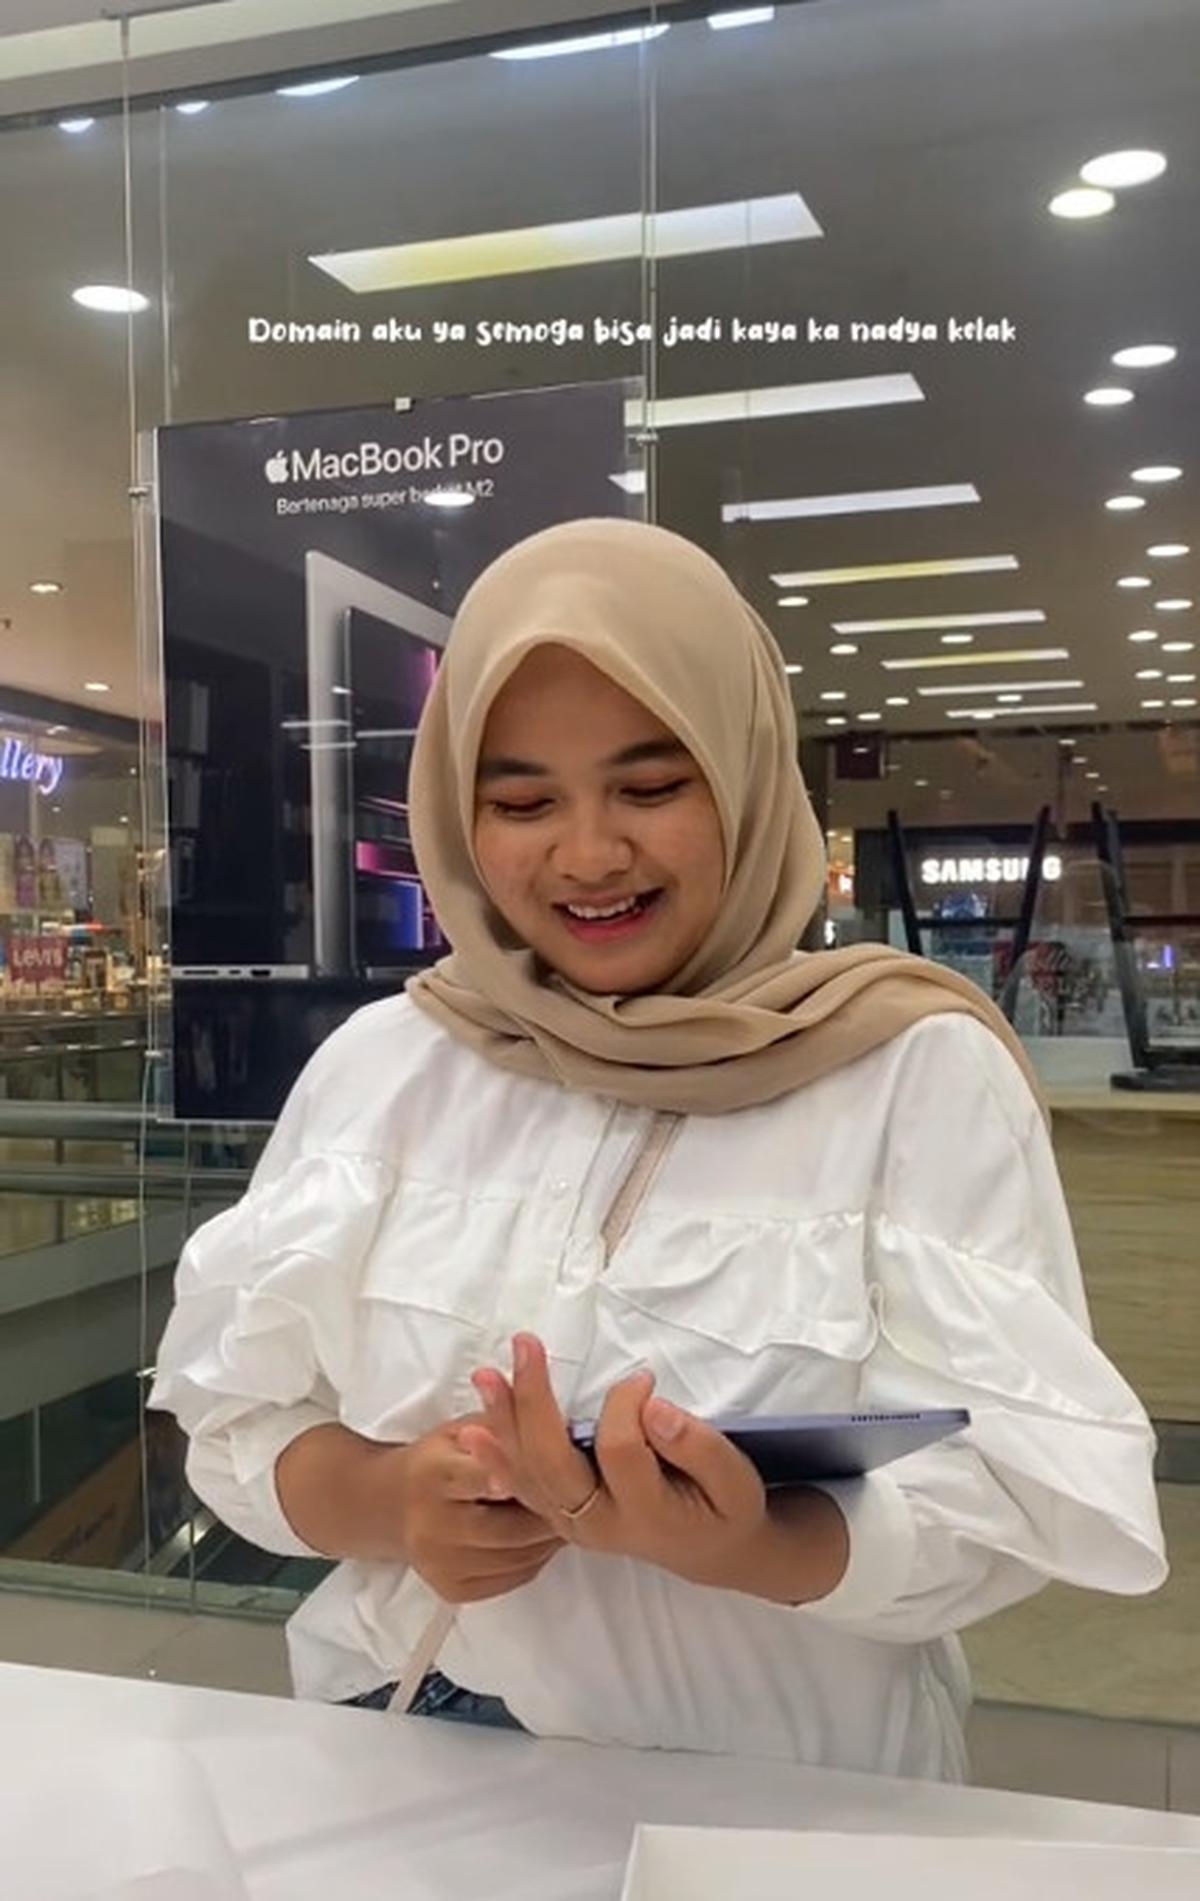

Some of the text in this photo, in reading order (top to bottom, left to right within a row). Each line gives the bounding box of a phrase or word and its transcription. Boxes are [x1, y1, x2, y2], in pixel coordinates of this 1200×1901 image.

[291, 433, 504, 482] MacBook Pro
[276, 495, 359, 515] Bertenaga
[361, 487, 407, 509] super
